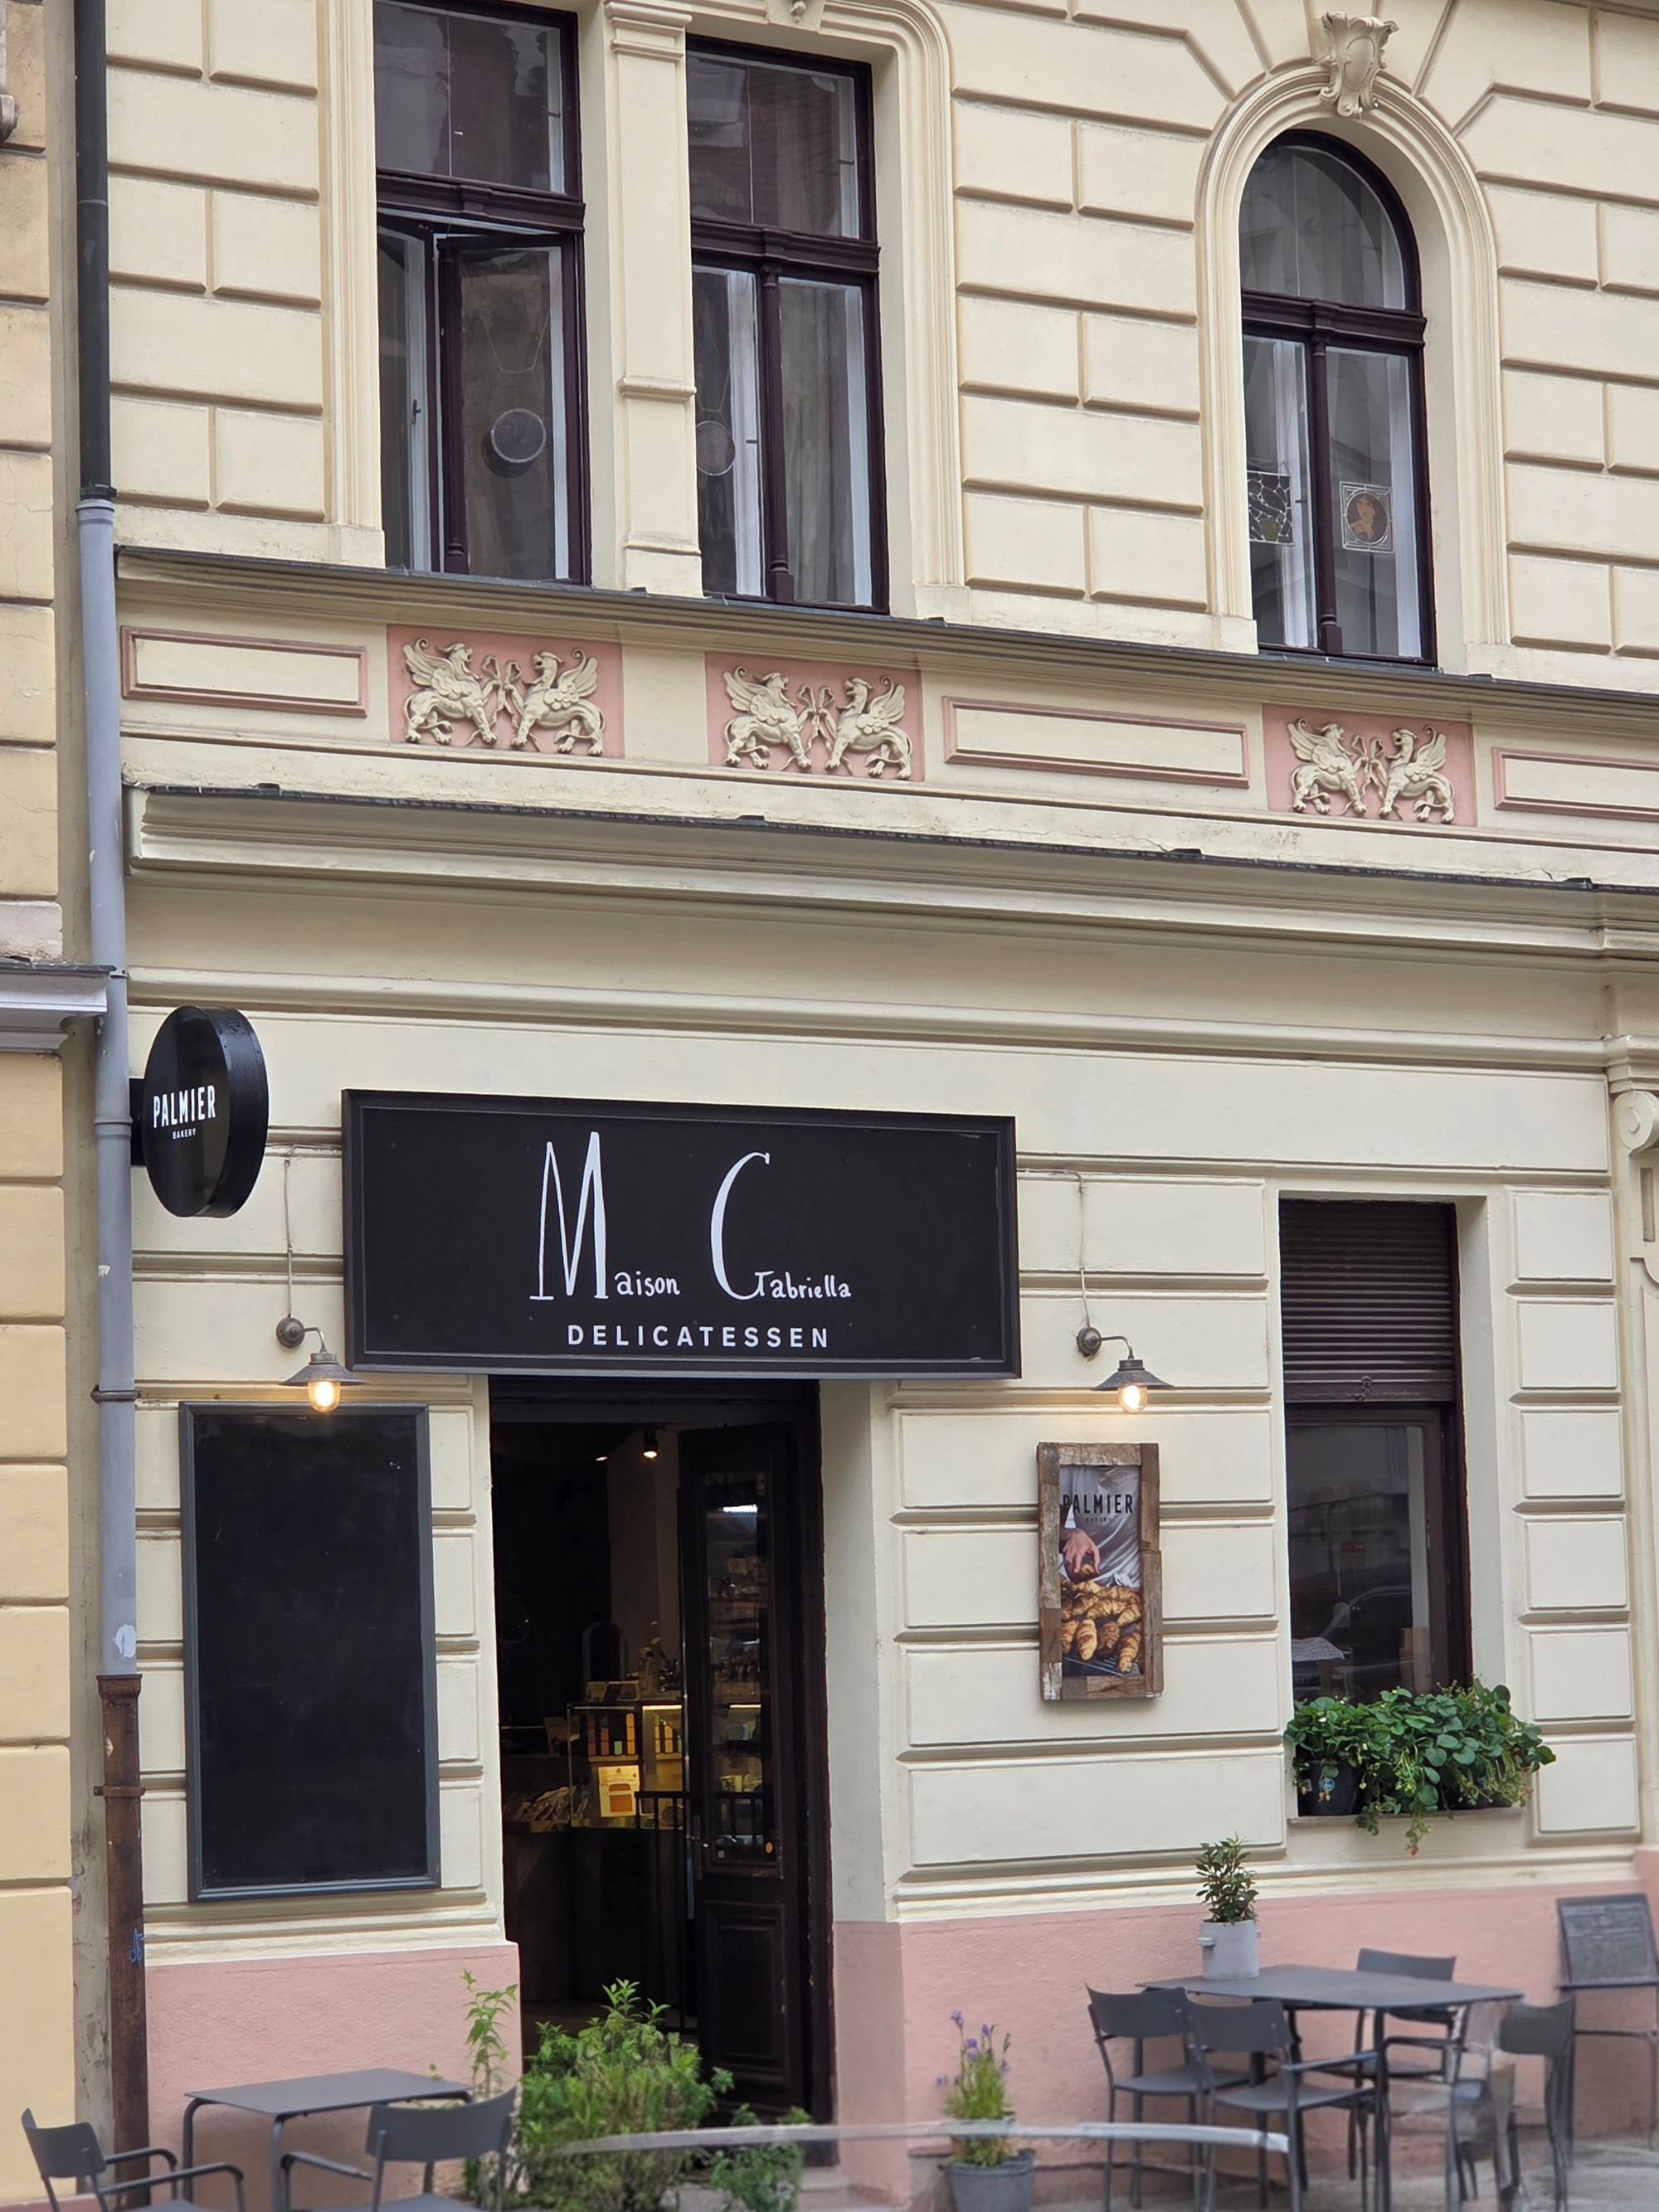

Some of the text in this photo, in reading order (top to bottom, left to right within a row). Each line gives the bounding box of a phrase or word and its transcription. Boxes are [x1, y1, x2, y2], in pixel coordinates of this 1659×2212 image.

[153, 1084, 216, 1129] PALMIER
[172, 1127, 197, 1140] BAKERY
[530, 1131, 852, 1300] Maison Gabriella
[567, 1325, 828, 1348] DELICATESSEN
[1062, 1494, 1133, 1514] PALMIER
